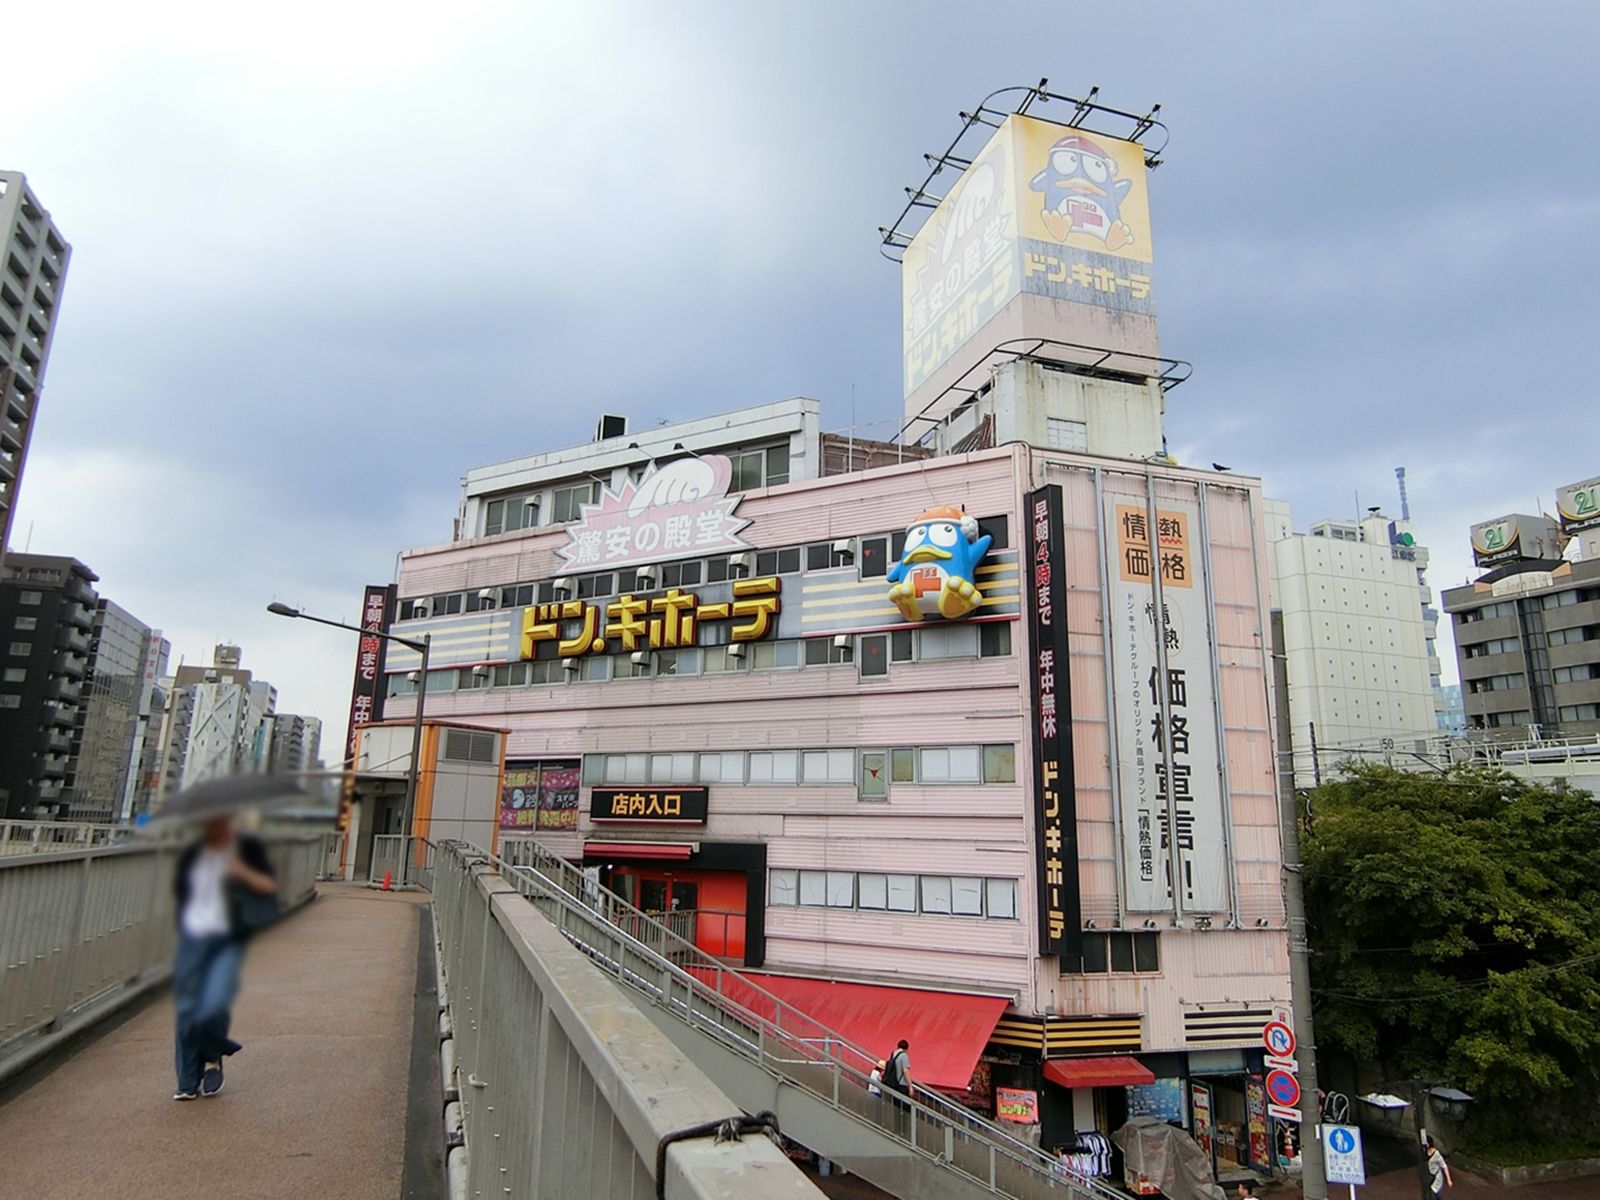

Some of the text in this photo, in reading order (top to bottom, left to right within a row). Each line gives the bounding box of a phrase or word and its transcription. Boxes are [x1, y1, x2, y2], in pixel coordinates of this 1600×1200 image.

[576, 507, 725, 564] 驚安の殿堂
[1034, 500, 1053, 627] 早朝4時まで
[1124, 547, 1186, 581] 価格
[1039, 650, 1058, 739] 年中無休
[610, 793, 682, 816] 店内入口
